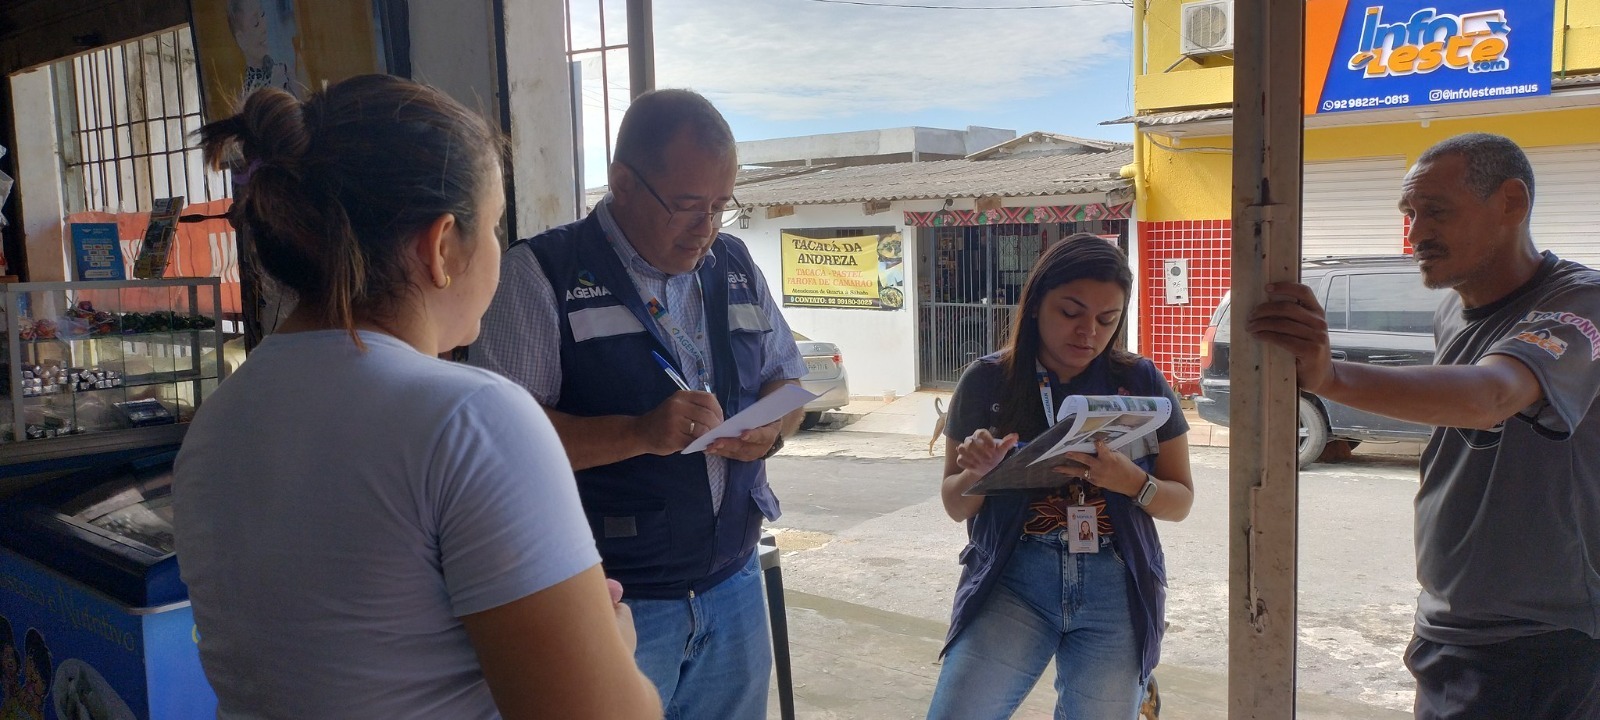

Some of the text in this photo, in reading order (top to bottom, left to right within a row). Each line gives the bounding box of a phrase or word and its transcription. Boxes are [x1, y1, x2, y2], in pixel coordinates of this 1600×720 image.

[1469, 60, 1506, 72] .com
[1443, 84, 1538, 100] @infolestemanaus
[1334, 95, 1409, 109] 92 98221-0813
[842, 242, 863, 252] DA
[797, 253, 858, 266] ANDREZA
[787, 277, 817, 285] FAROFA
[565, 285, 613, 302] AGEMA
[795, 296, 827, 304] CONTATO:
[676, 334, 702, 360] AGEMA
